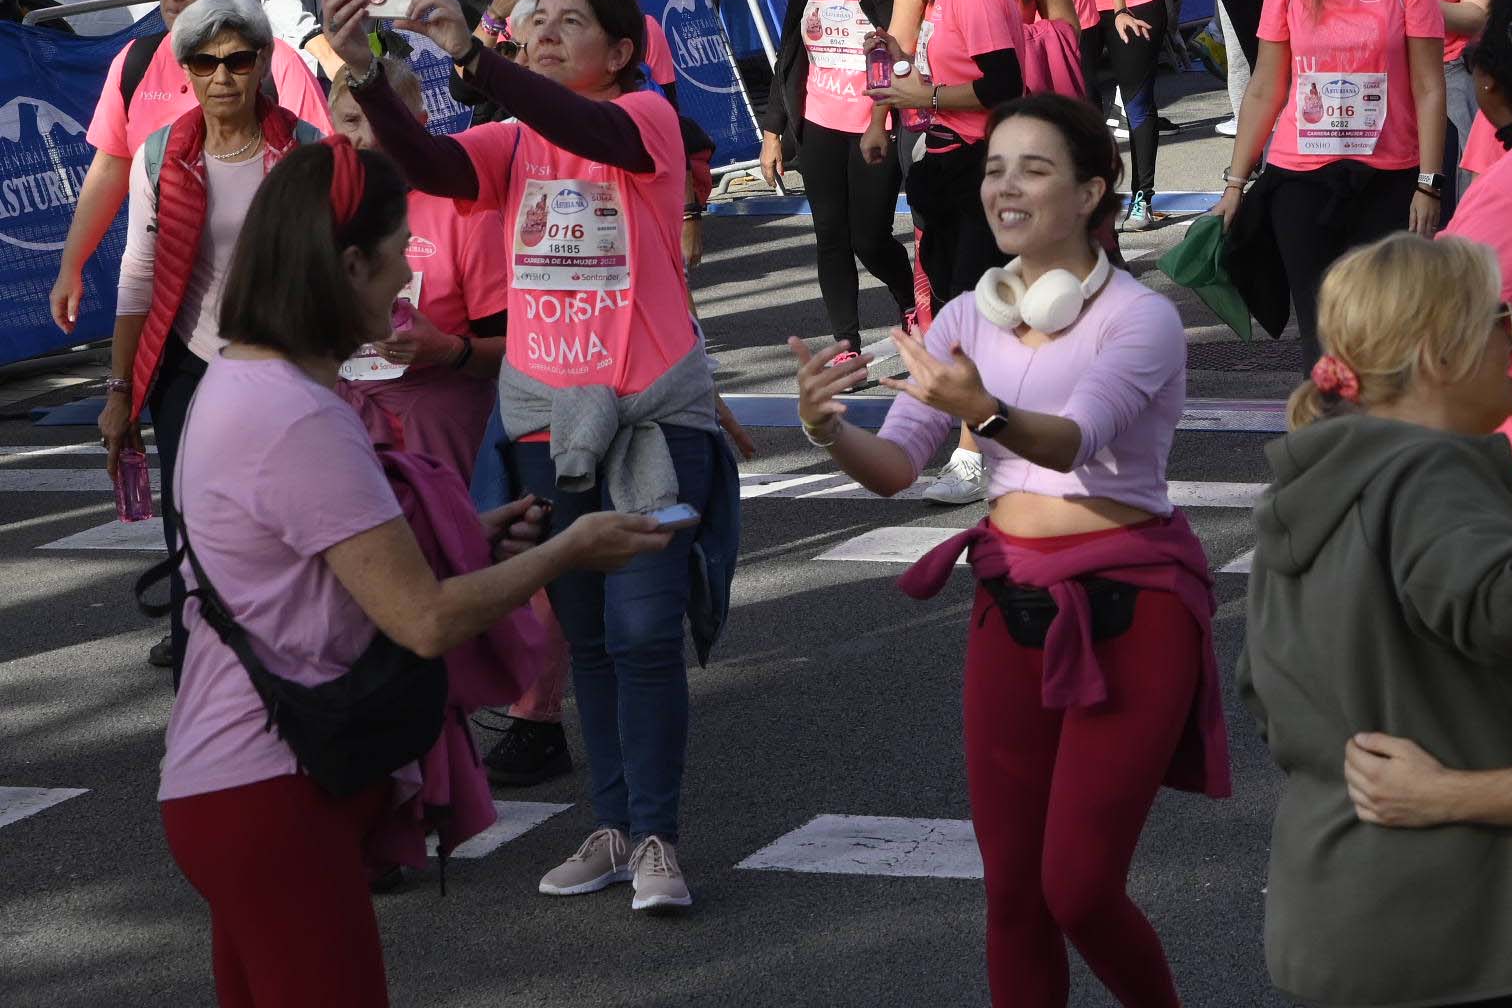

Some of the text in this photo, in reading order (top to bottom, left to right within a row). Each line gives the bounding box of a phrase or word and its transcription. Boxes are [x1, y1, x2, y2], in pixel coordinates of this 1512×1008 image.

[824, 26, 850, 37] 016
[671, 25, 729, 69] ASTUR
[1326, 105, 1355, 117] 016
[547, 223, 585, 239] 016
[549, 244, 580, 254] 18185
[527, 330, 608, 365] SUMA
